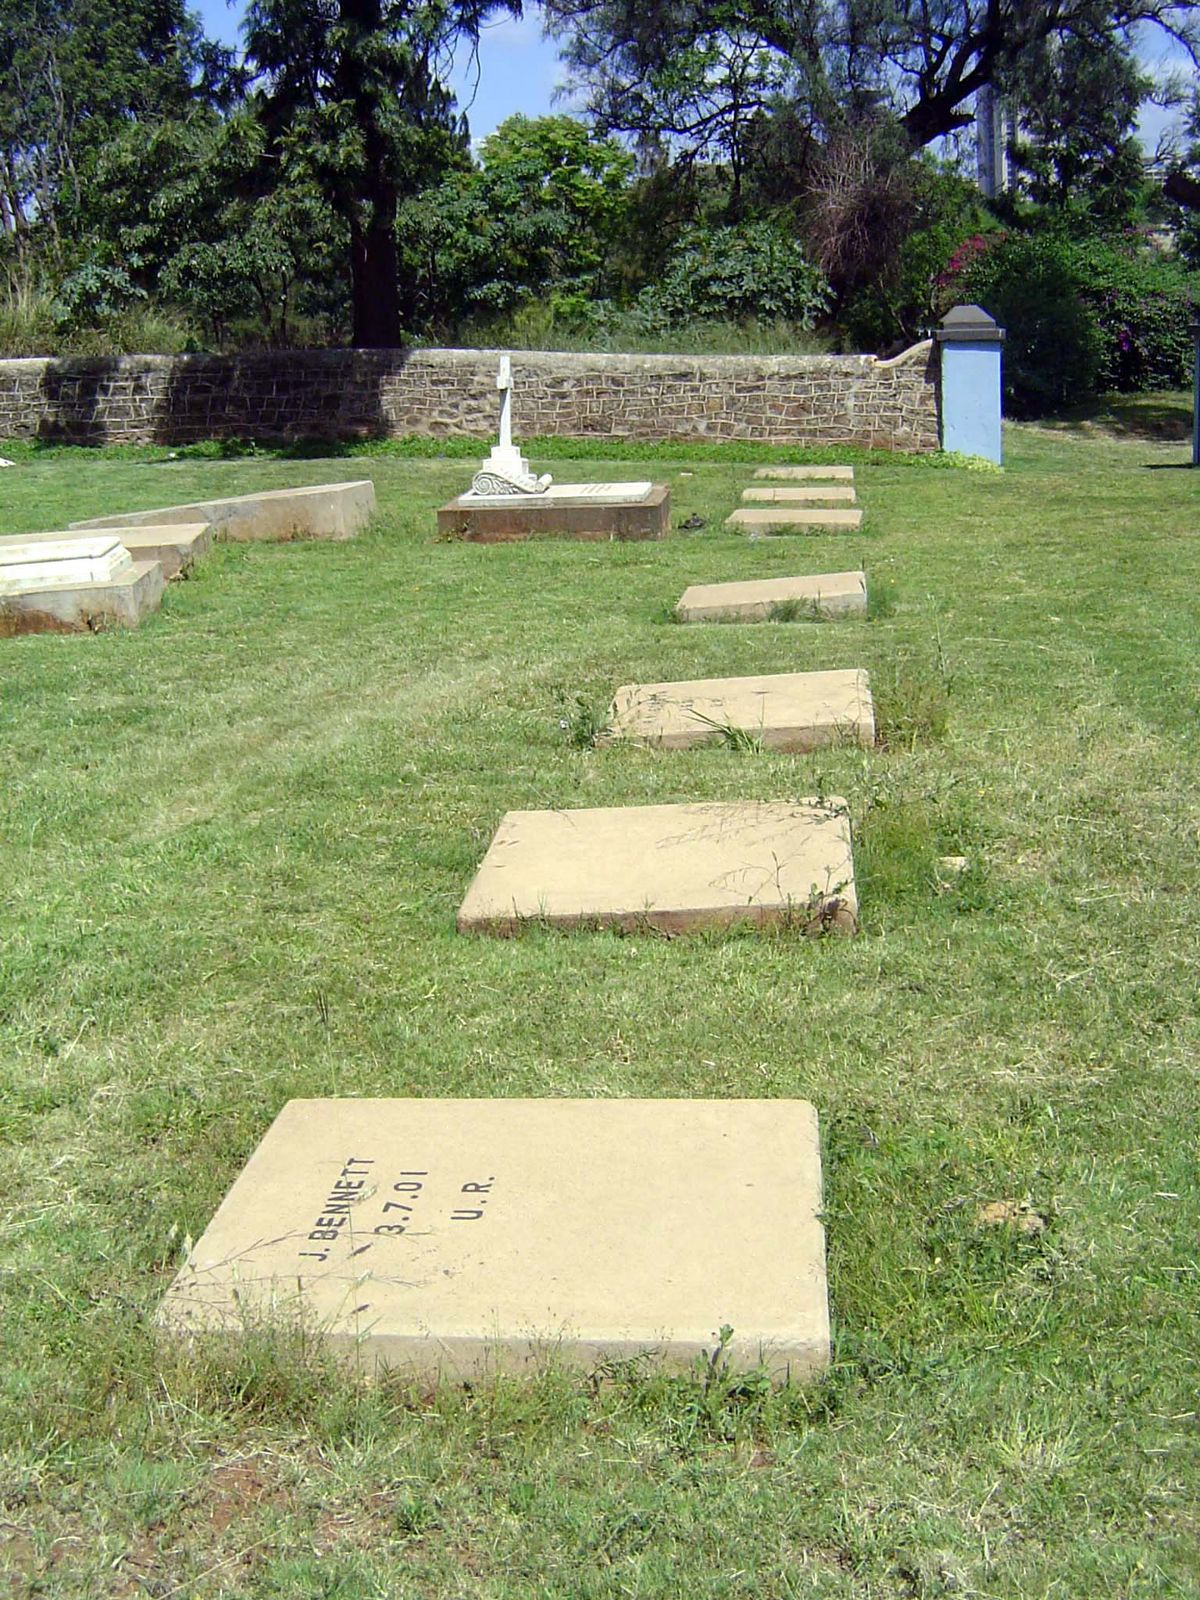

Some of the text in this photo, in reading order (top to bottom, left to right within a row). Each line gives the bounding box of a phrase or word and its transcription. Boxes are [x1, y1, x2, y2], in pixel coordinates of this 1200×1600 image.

[298, 1157, 375, 1262] J. BENNETT
[373, 1171, 428, 1235] 3.7.01
[450, 1176, 495, 1221] U.R.
